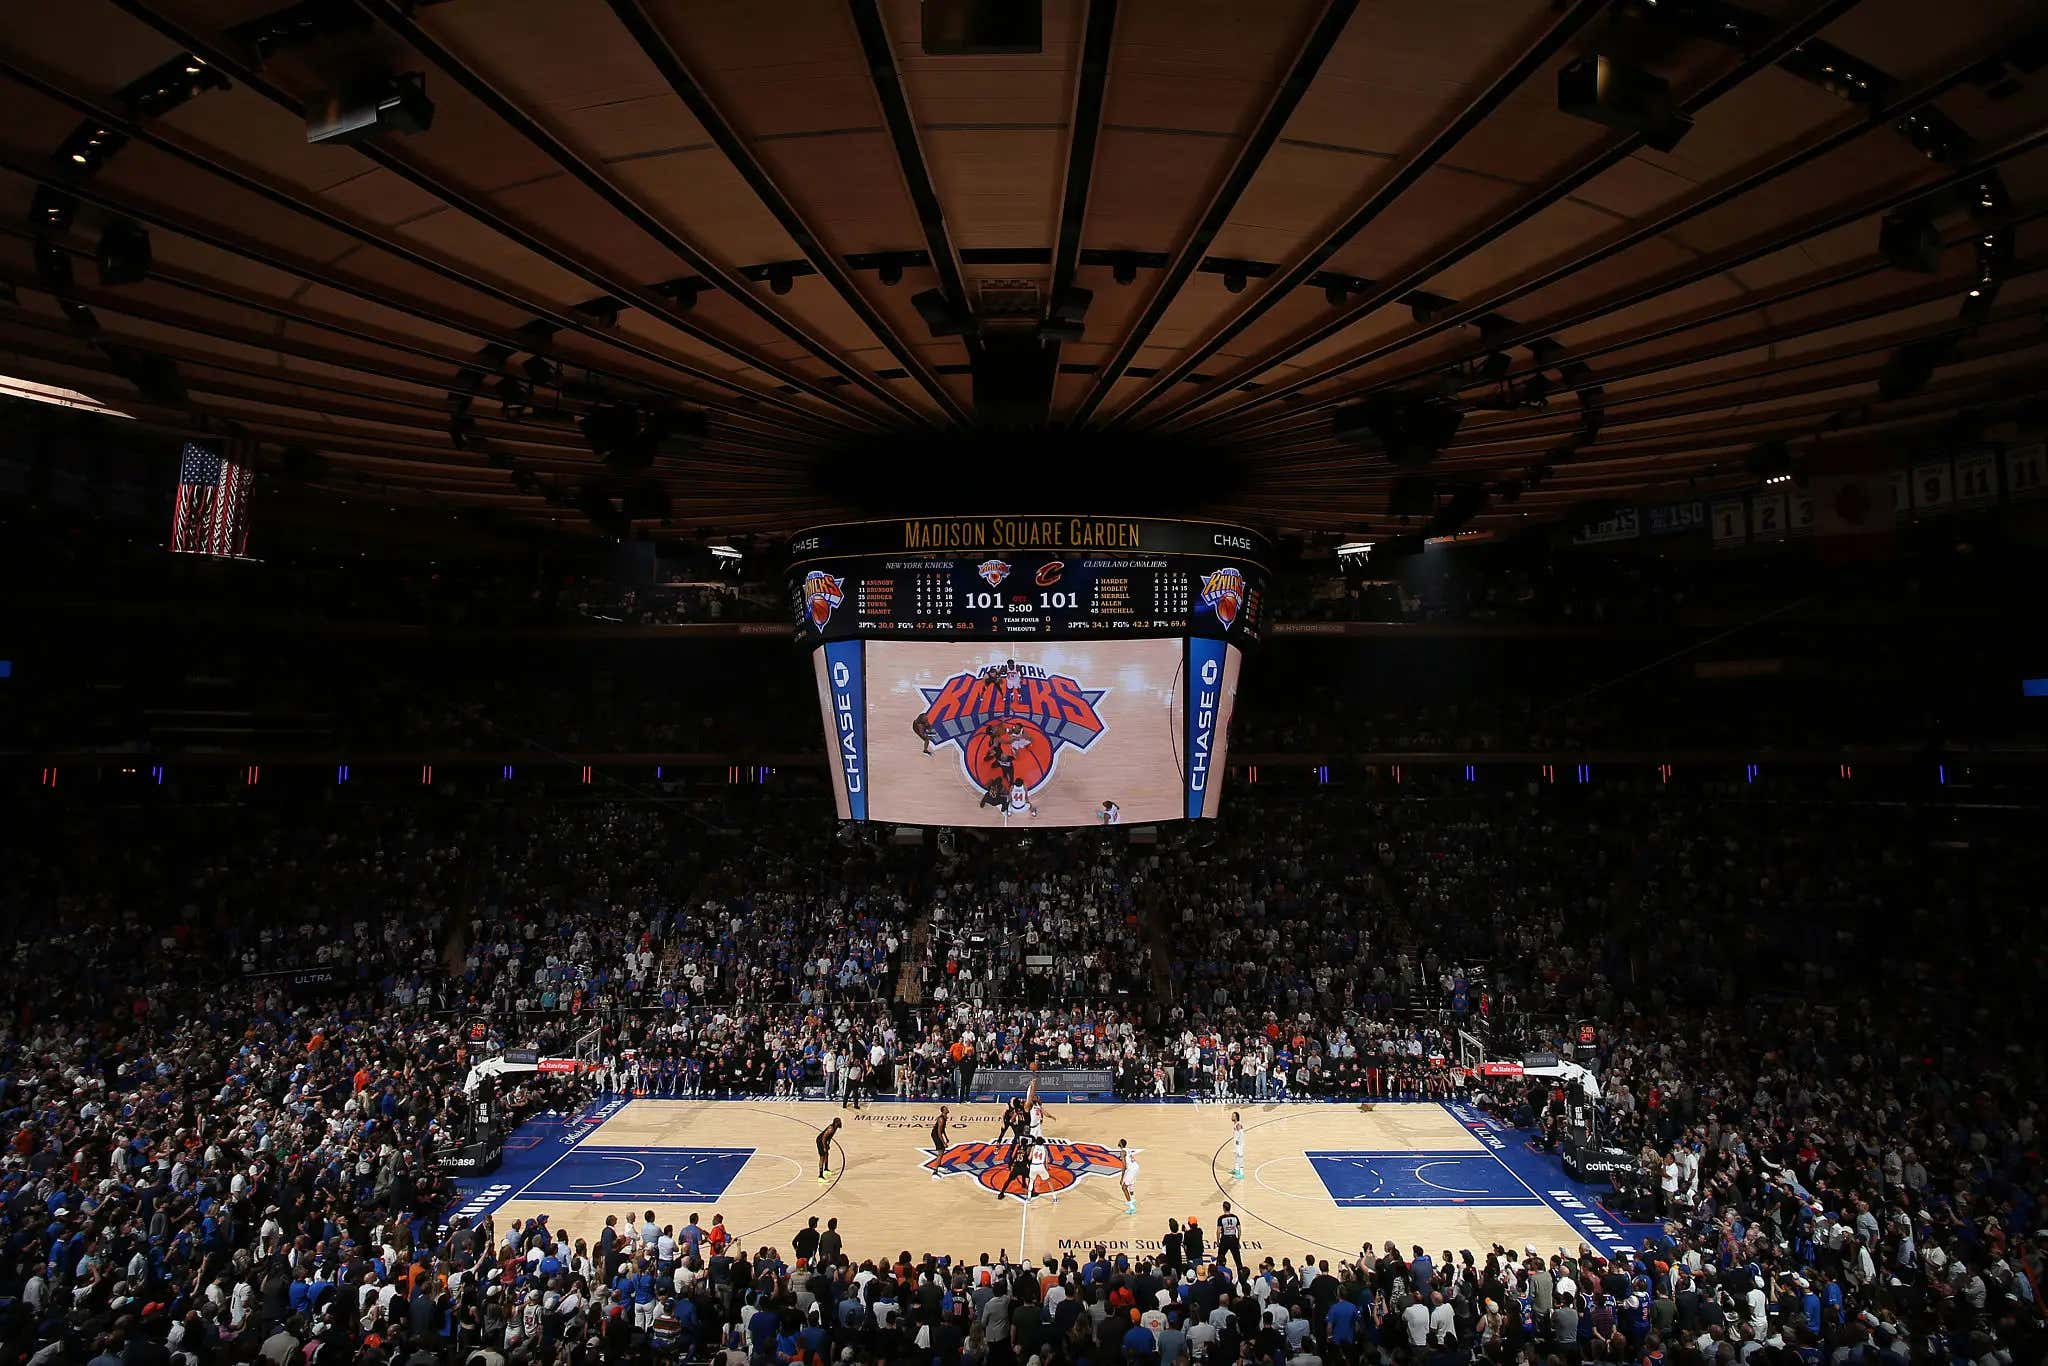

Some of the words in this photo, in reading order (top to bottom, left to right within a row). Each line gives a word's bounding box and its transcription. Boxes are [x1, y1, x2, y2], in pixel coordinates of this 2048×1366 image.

[905, 520, 986, 549] MADISON
[992, 518, 1063, 548] SQUARE
[1070, 518, 1140, 549] GARDEN
[1213, 535, 1251, 551] CHASE
[925, 561, 955, 569] KNICKS
[965, 592, 1004, 609] 101
[1008, 604, 1033, 612] 5:00
[1040, 592, 1079, 608] 101
[1068, 621, 1089, 629] 3PT%
[1171, 619, 1187, 627] 69.6
[838, 694, 862, 793] CHASE
[1191, 690, 1215, 791] CHASE
[295, 974, 333, 985] ULTRA
[854, 1114, 908, 1122] MADISON
[1474, 1127, 1507, 1150] ULTRA
[1034, 1152, 1043, 1160] 44
[1547, 1190, 1587, 1209] NEW
[1573, 1213, 1624, 1241] YORK
[1058, 1239, 1129, 1250] MADISON
